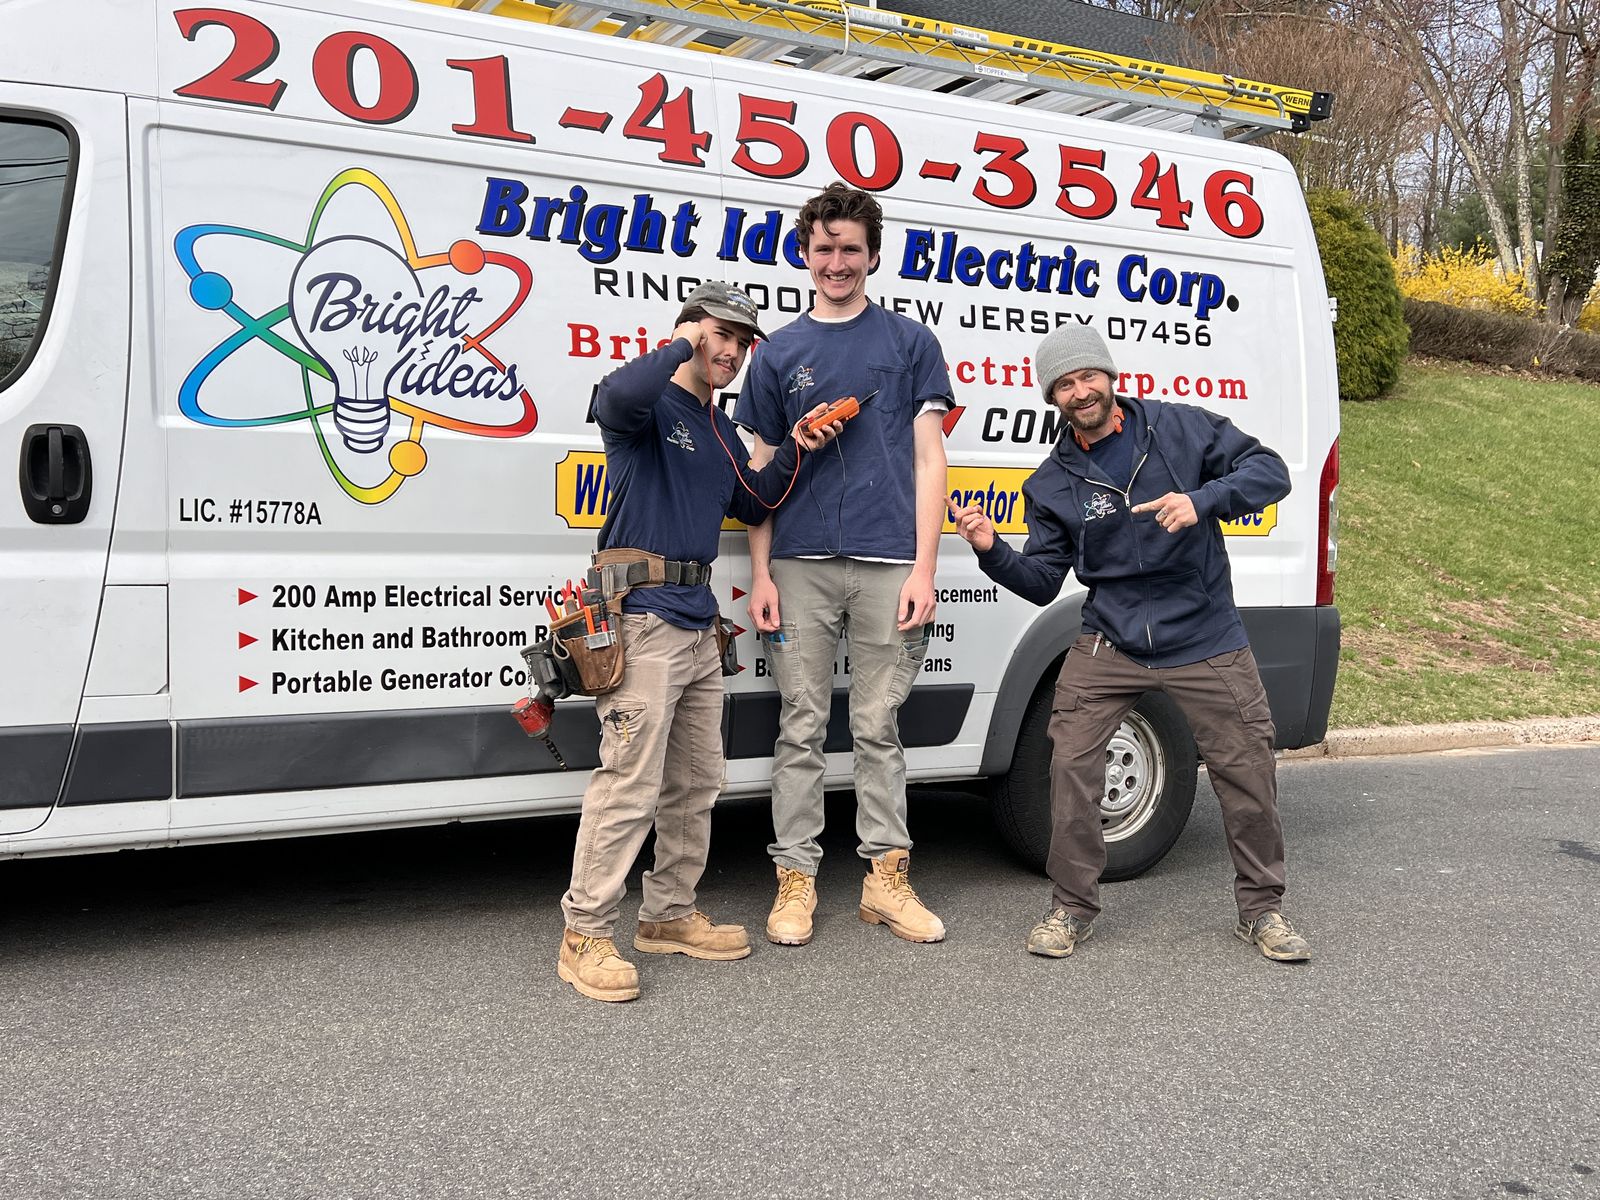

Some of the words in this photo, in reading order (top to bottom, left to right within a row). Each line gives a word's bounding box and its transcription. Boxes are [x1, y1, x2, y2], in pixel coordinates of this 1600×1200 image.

[1285, 95, 1311, 106] WERN
[174, 7, 1265, 239] 201-450-3546
[477, 177, 702, 264] Bright
[716, 206, 881, 275] Ide
[899, 228, 1100, 298] Electric
[1117, 254, 1240, 320] Corp.
[306, 272, 484, 353] Bright
[1108, 316, 1212, 347] 07456
[179, 498, 222, 523] LIC.
[229, 499, 322, 525] #15778A
[272, 584, 316, 608] 200
[324, 584, 377, 613] Amp
[385, 584, 491, 608] Electrical
[272, 627, 364, 652] Kitchen
[372, 626, 414, 650] and
[422, 625, 527, 649] Bathroom
[272, 669, 373, 695] Portable
[380, 667, 493, 691] Generator
